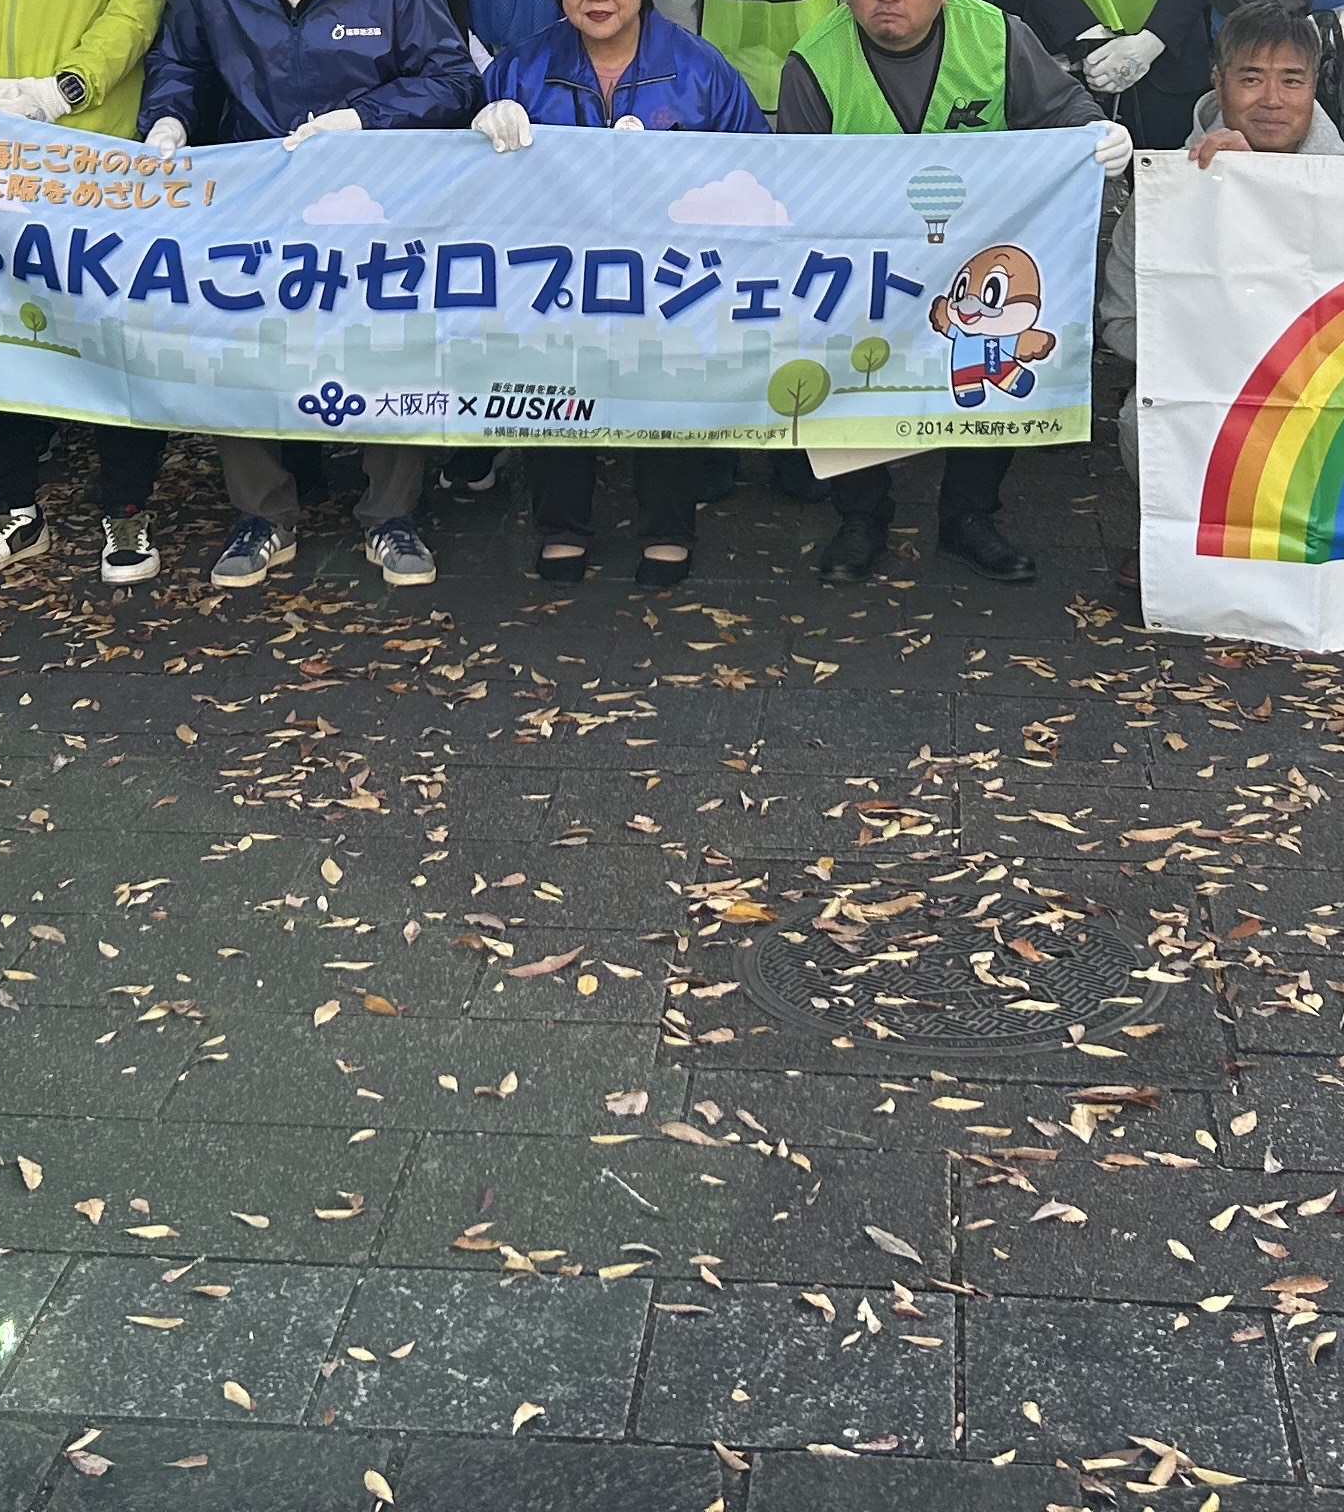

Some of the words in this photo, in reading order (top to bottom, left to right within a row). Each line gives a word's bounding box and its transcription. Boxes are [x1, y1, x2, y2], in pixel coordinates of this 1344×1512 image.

[375, 390, 450, 418] 大阪府
[484, 395, 596, 421] DUSKIN
[916, 421, 955, 436] 2014
[959, 418, 1063, 437] 大阪府もずやん
